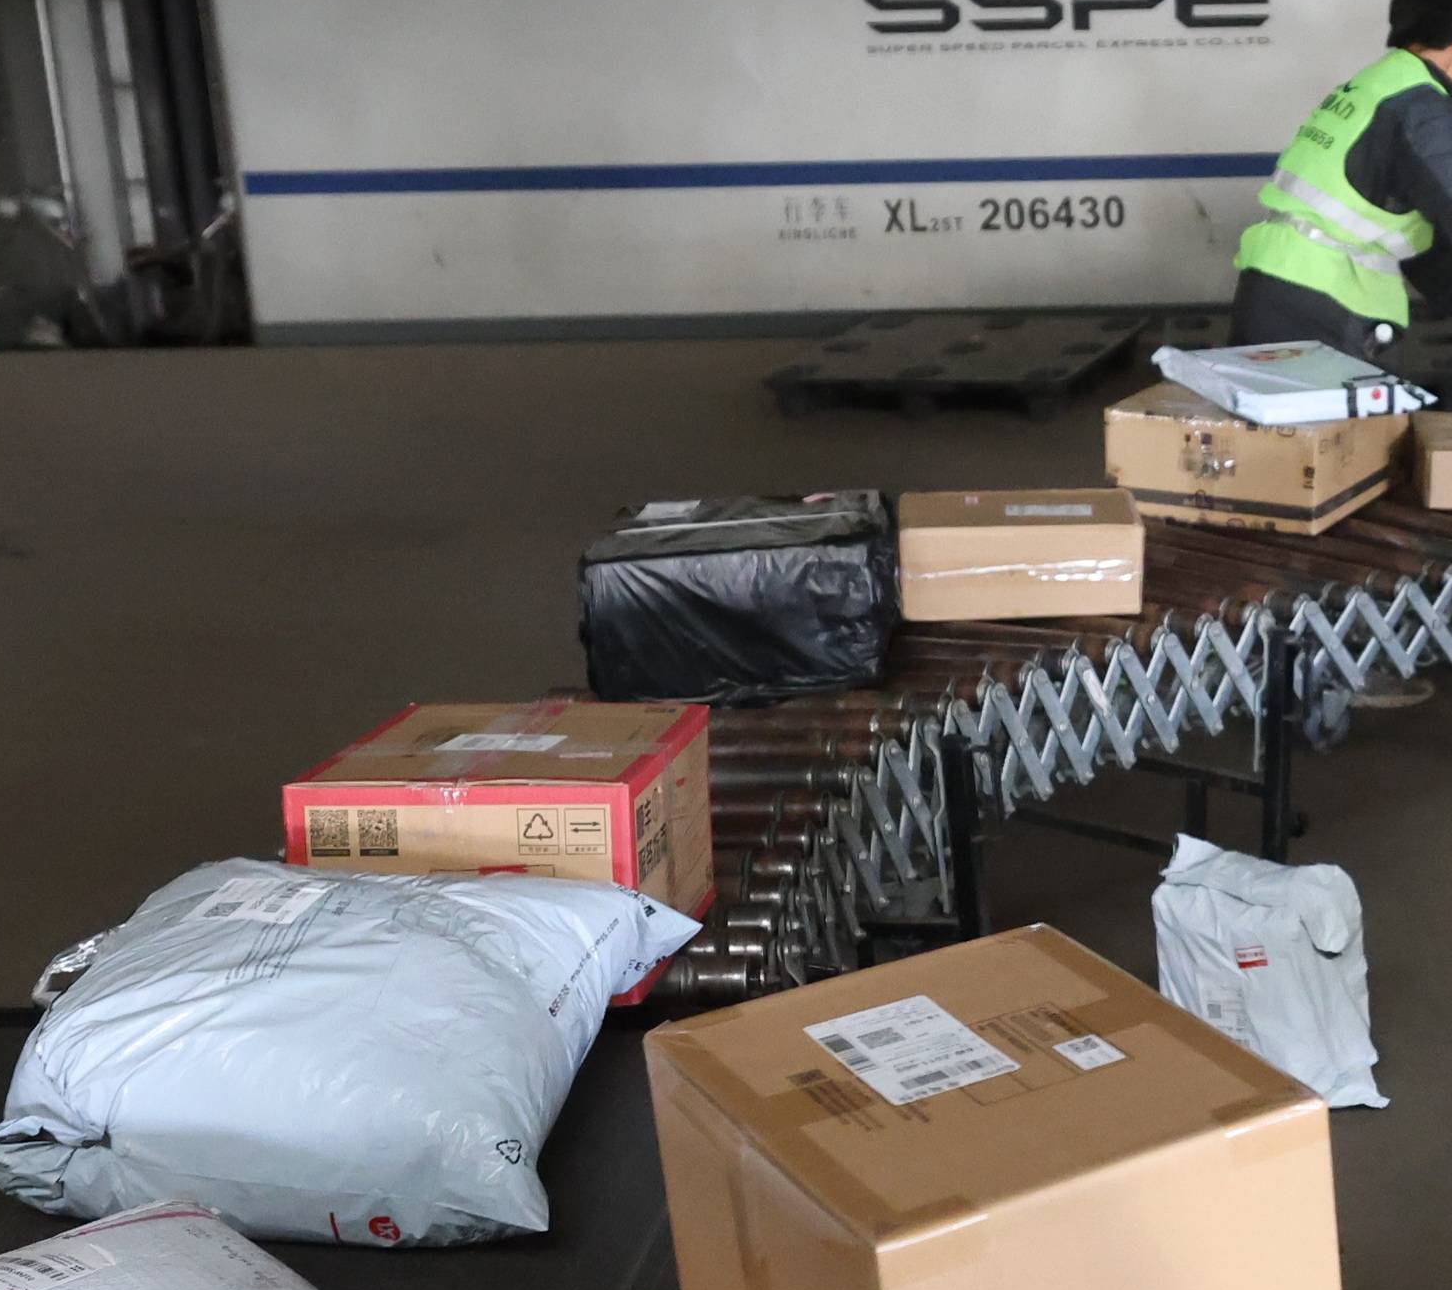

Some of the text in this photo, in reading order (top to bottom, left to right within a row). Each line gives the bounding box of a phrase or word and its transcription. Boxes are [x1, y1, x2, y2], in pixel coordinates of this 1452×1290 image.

[865, 42, 933, 55] SUPER
[939, 40, 1005, 53] SPEED
[1011, 39, 1088, 52] PARCEL
[1095, 37, 1189, 50] EXPRESS
[979, 195, 1125, 231] 206430
